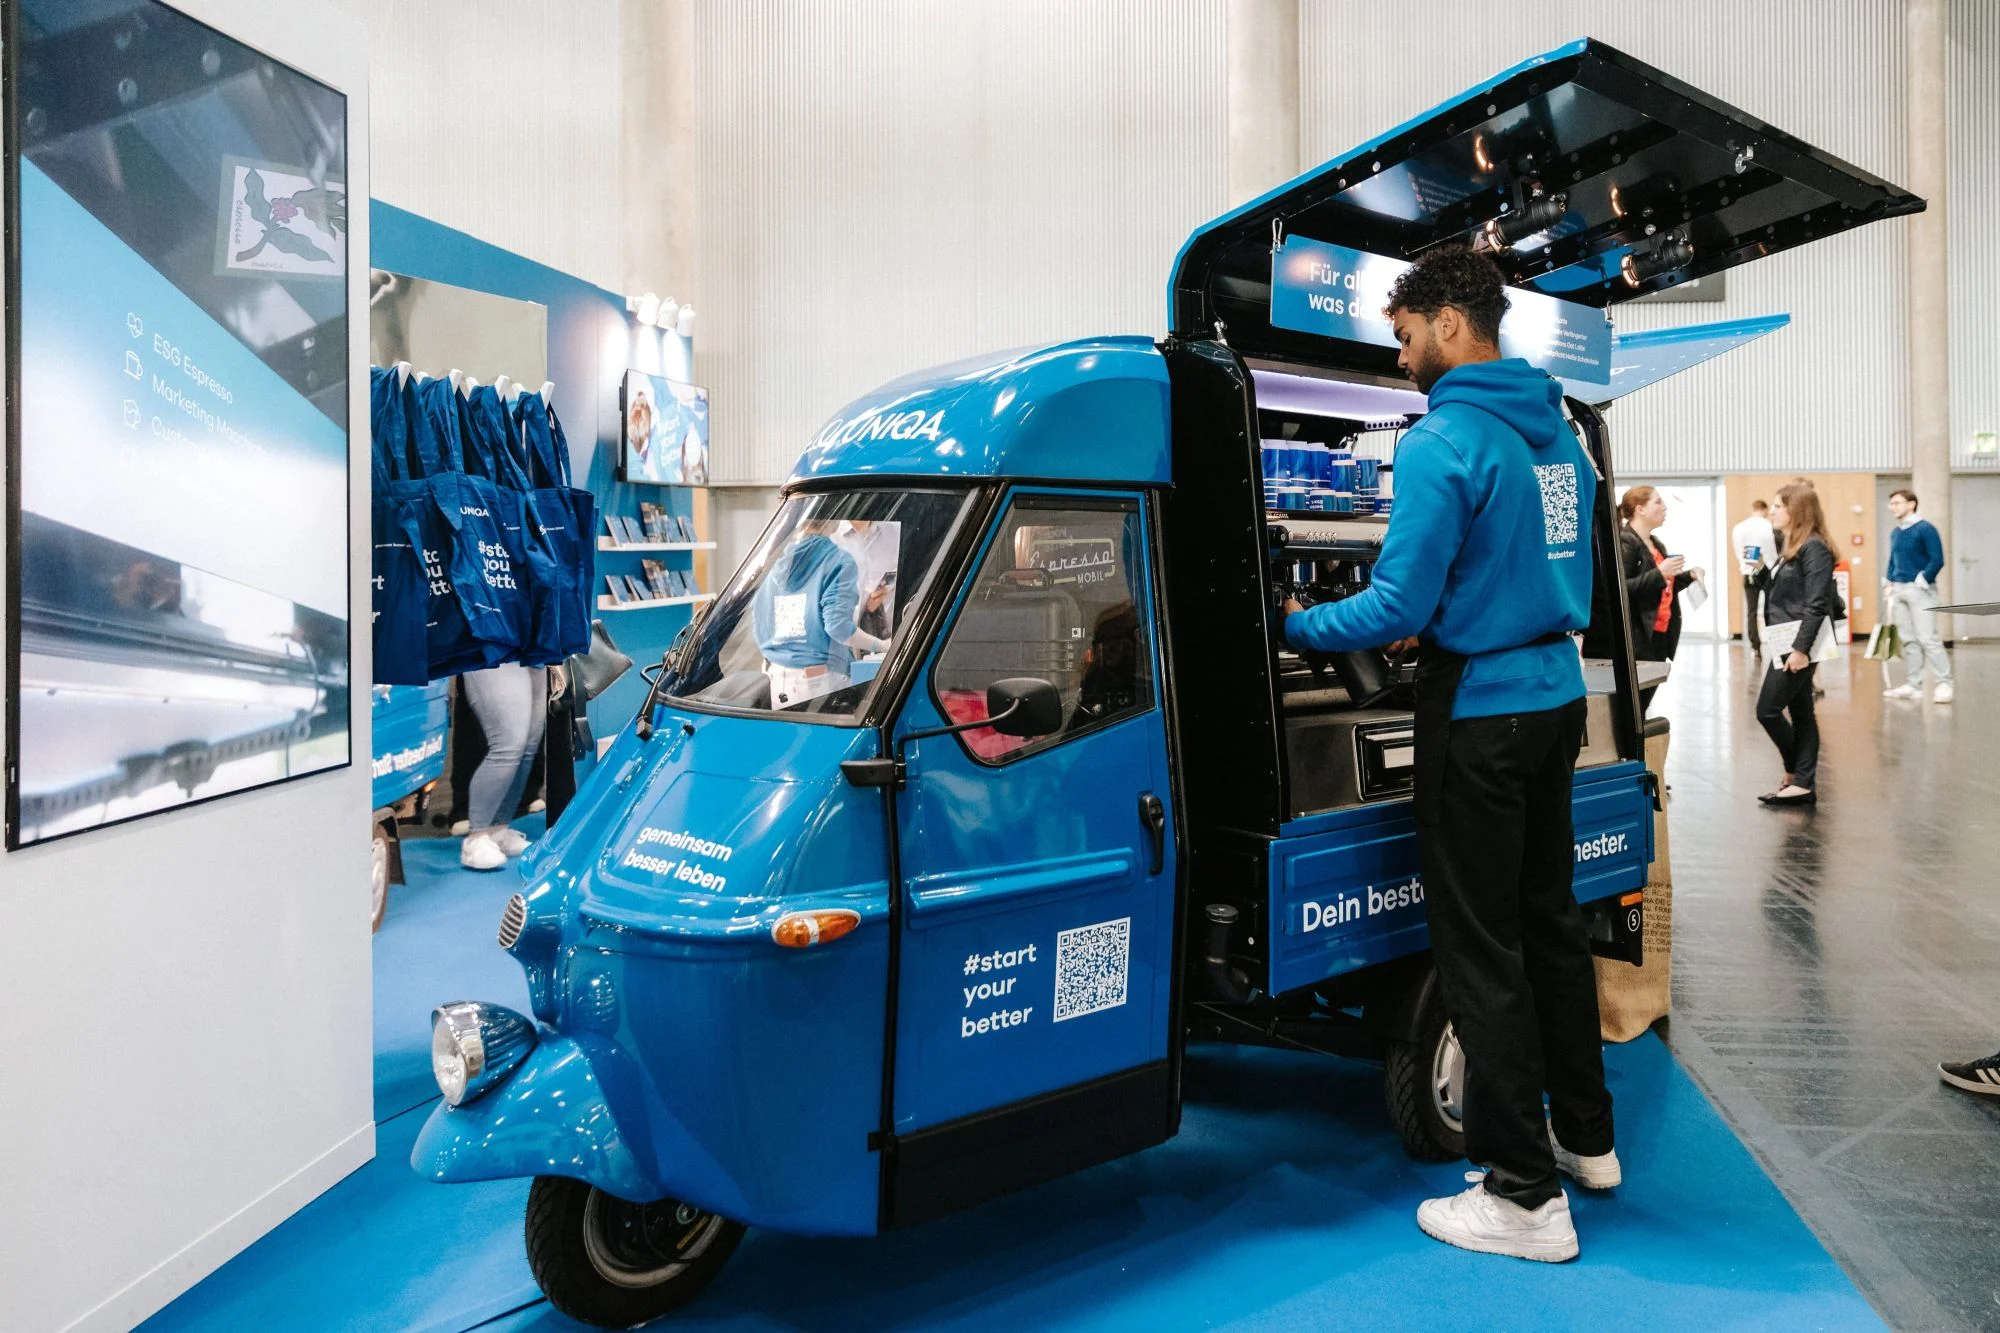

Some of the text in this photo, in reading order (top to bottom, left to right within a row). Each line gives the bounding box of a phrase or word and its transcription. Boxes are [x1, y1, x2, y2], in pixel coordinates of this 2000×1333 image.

[1310, 262, 1340, 286] Für
[1309, 293, 1344, 315] was
[153, 332, 233, 404] ESG Espresso
[152, 374, 215, 433] Marketing
[483, 557, 511, 573] you
[1077, 570, 1105, 585] MOBIL
[637, 827, 732, 861] gemeinsam
[624, 848, 726, 892] besser leben
[1303, 893, 1360, 932] Dein
[963, 944, 1037, 975] #start
[963, 977, 1016, 1008] your
[961, 1007, 1033, 1038] better
